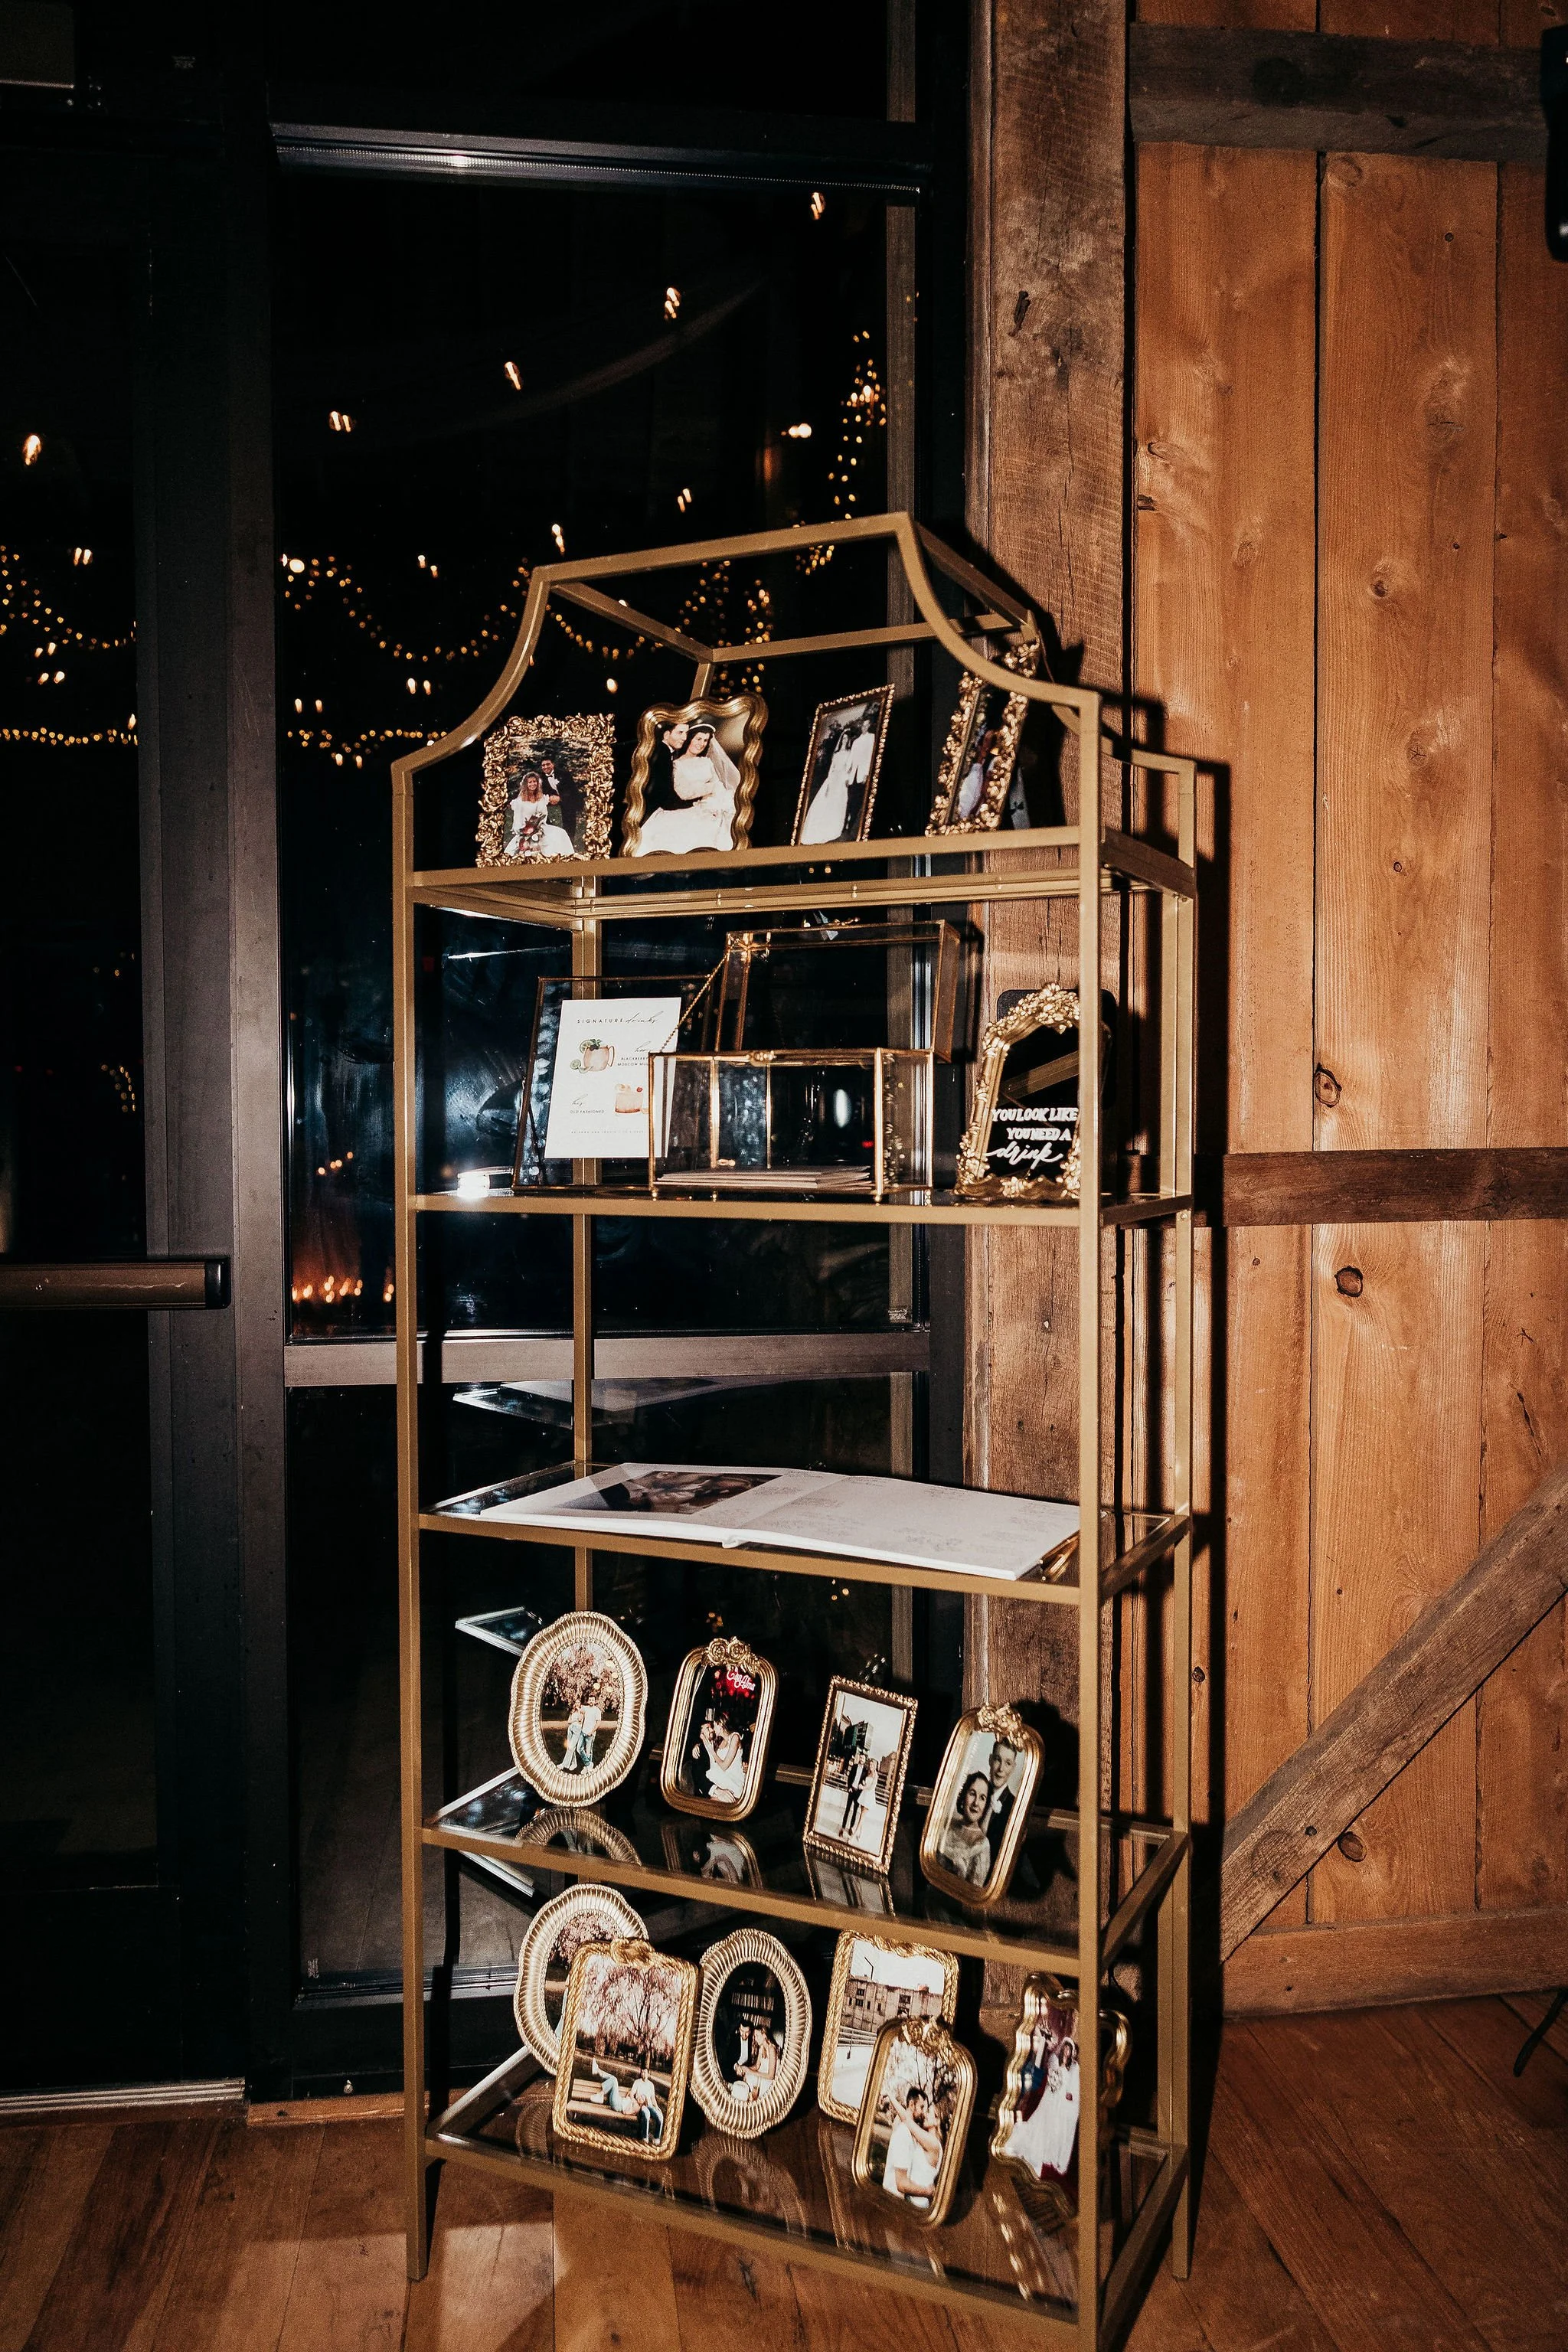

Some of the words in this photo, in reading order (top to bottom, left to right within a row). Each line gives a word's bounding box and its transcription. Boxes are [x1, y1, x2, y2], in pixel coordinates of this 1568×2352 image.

[991, 1108, 1018, 1122] YOU
[1016, 1108, 1050, 1122] LOOK
[1048, 1107, 1079, 1122] LIKE
[1006, 1127, 1031, 1139] YOU
[1030, 1128, 1061, 1141] NEED
[1059, 1128, 1072, 1141] A
[985, 1140, 1063, 1170] drink
